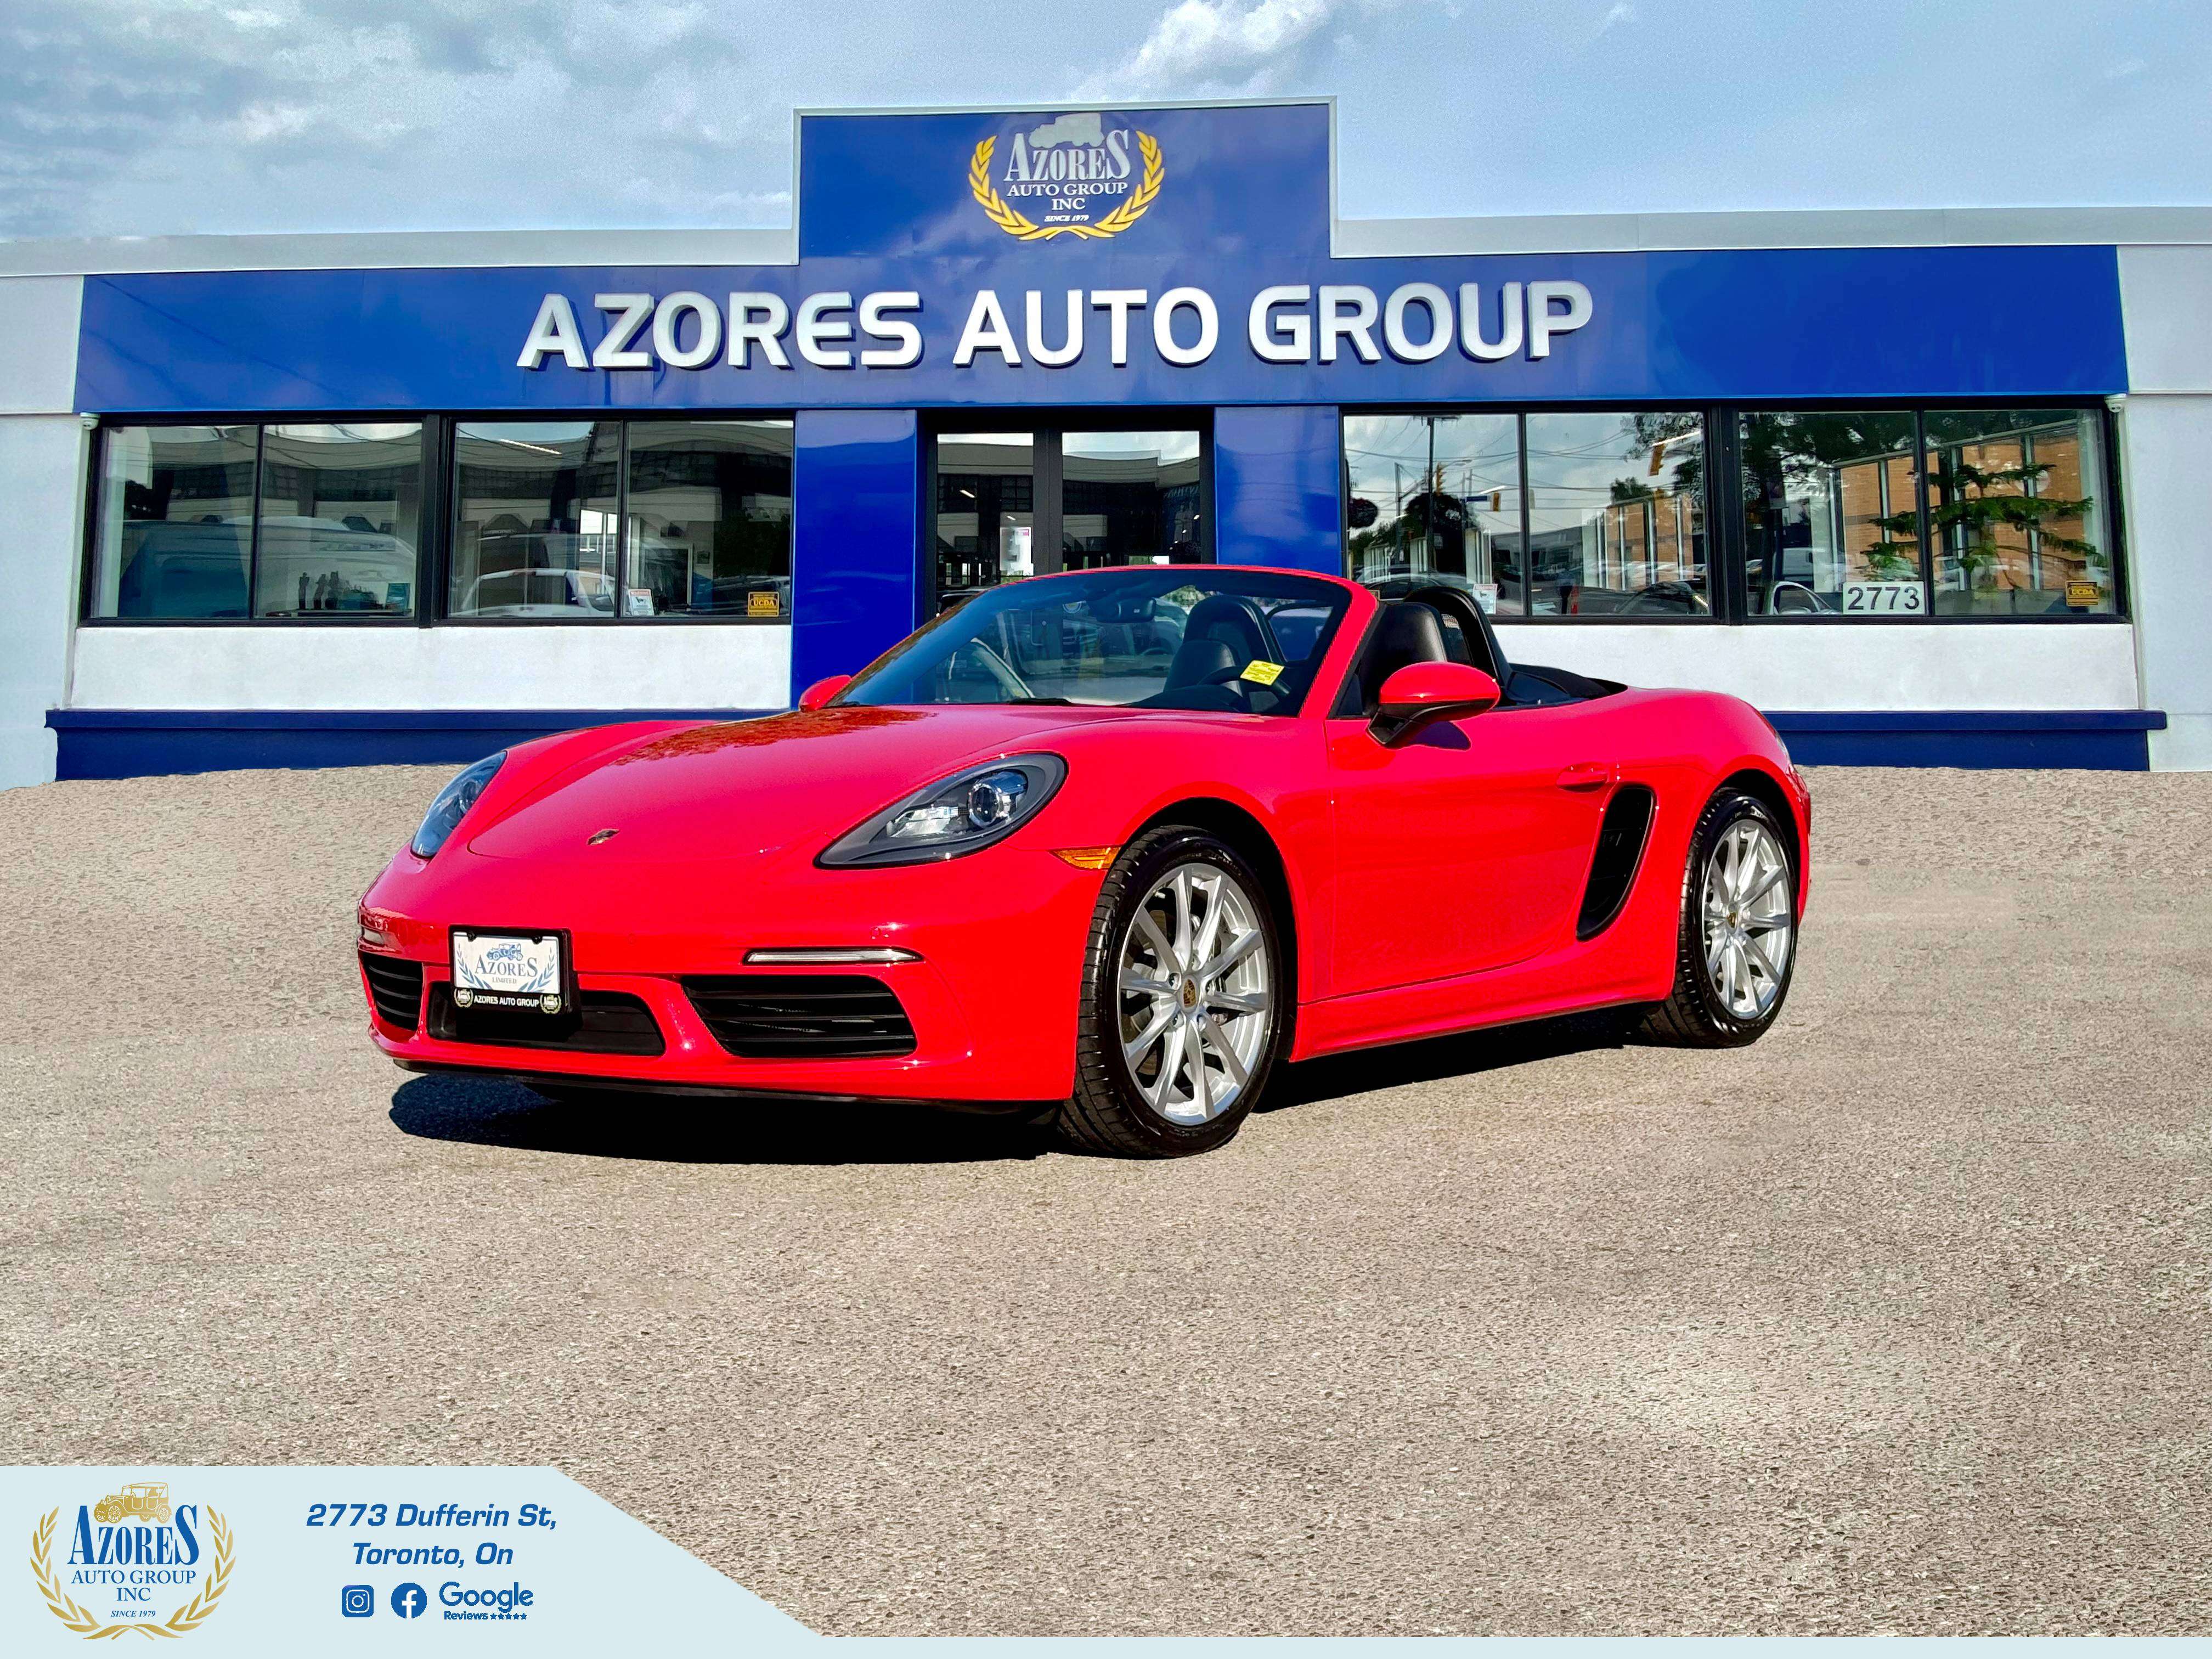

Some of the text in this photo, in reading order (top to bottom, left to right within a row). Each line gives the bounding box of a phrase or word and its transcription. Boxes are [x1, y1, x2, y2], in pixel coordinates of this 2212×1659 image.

[1003, 129, 1131, 182] AZORES
[1007, 182, 1128, 198] AUTO GROUP
[1051, 198, 1086, 211] INC
[516, 280, 1593, 370] AZORES AUTO GROUP
[1847, 586, 1920, 610] 2773
[475, 955, 538, 978] AZORES
[474, 995, 498, 1005] AZORES
[499, 997, 516, 1006] AUTO
[517, 998, 539, 1007] GROUP
